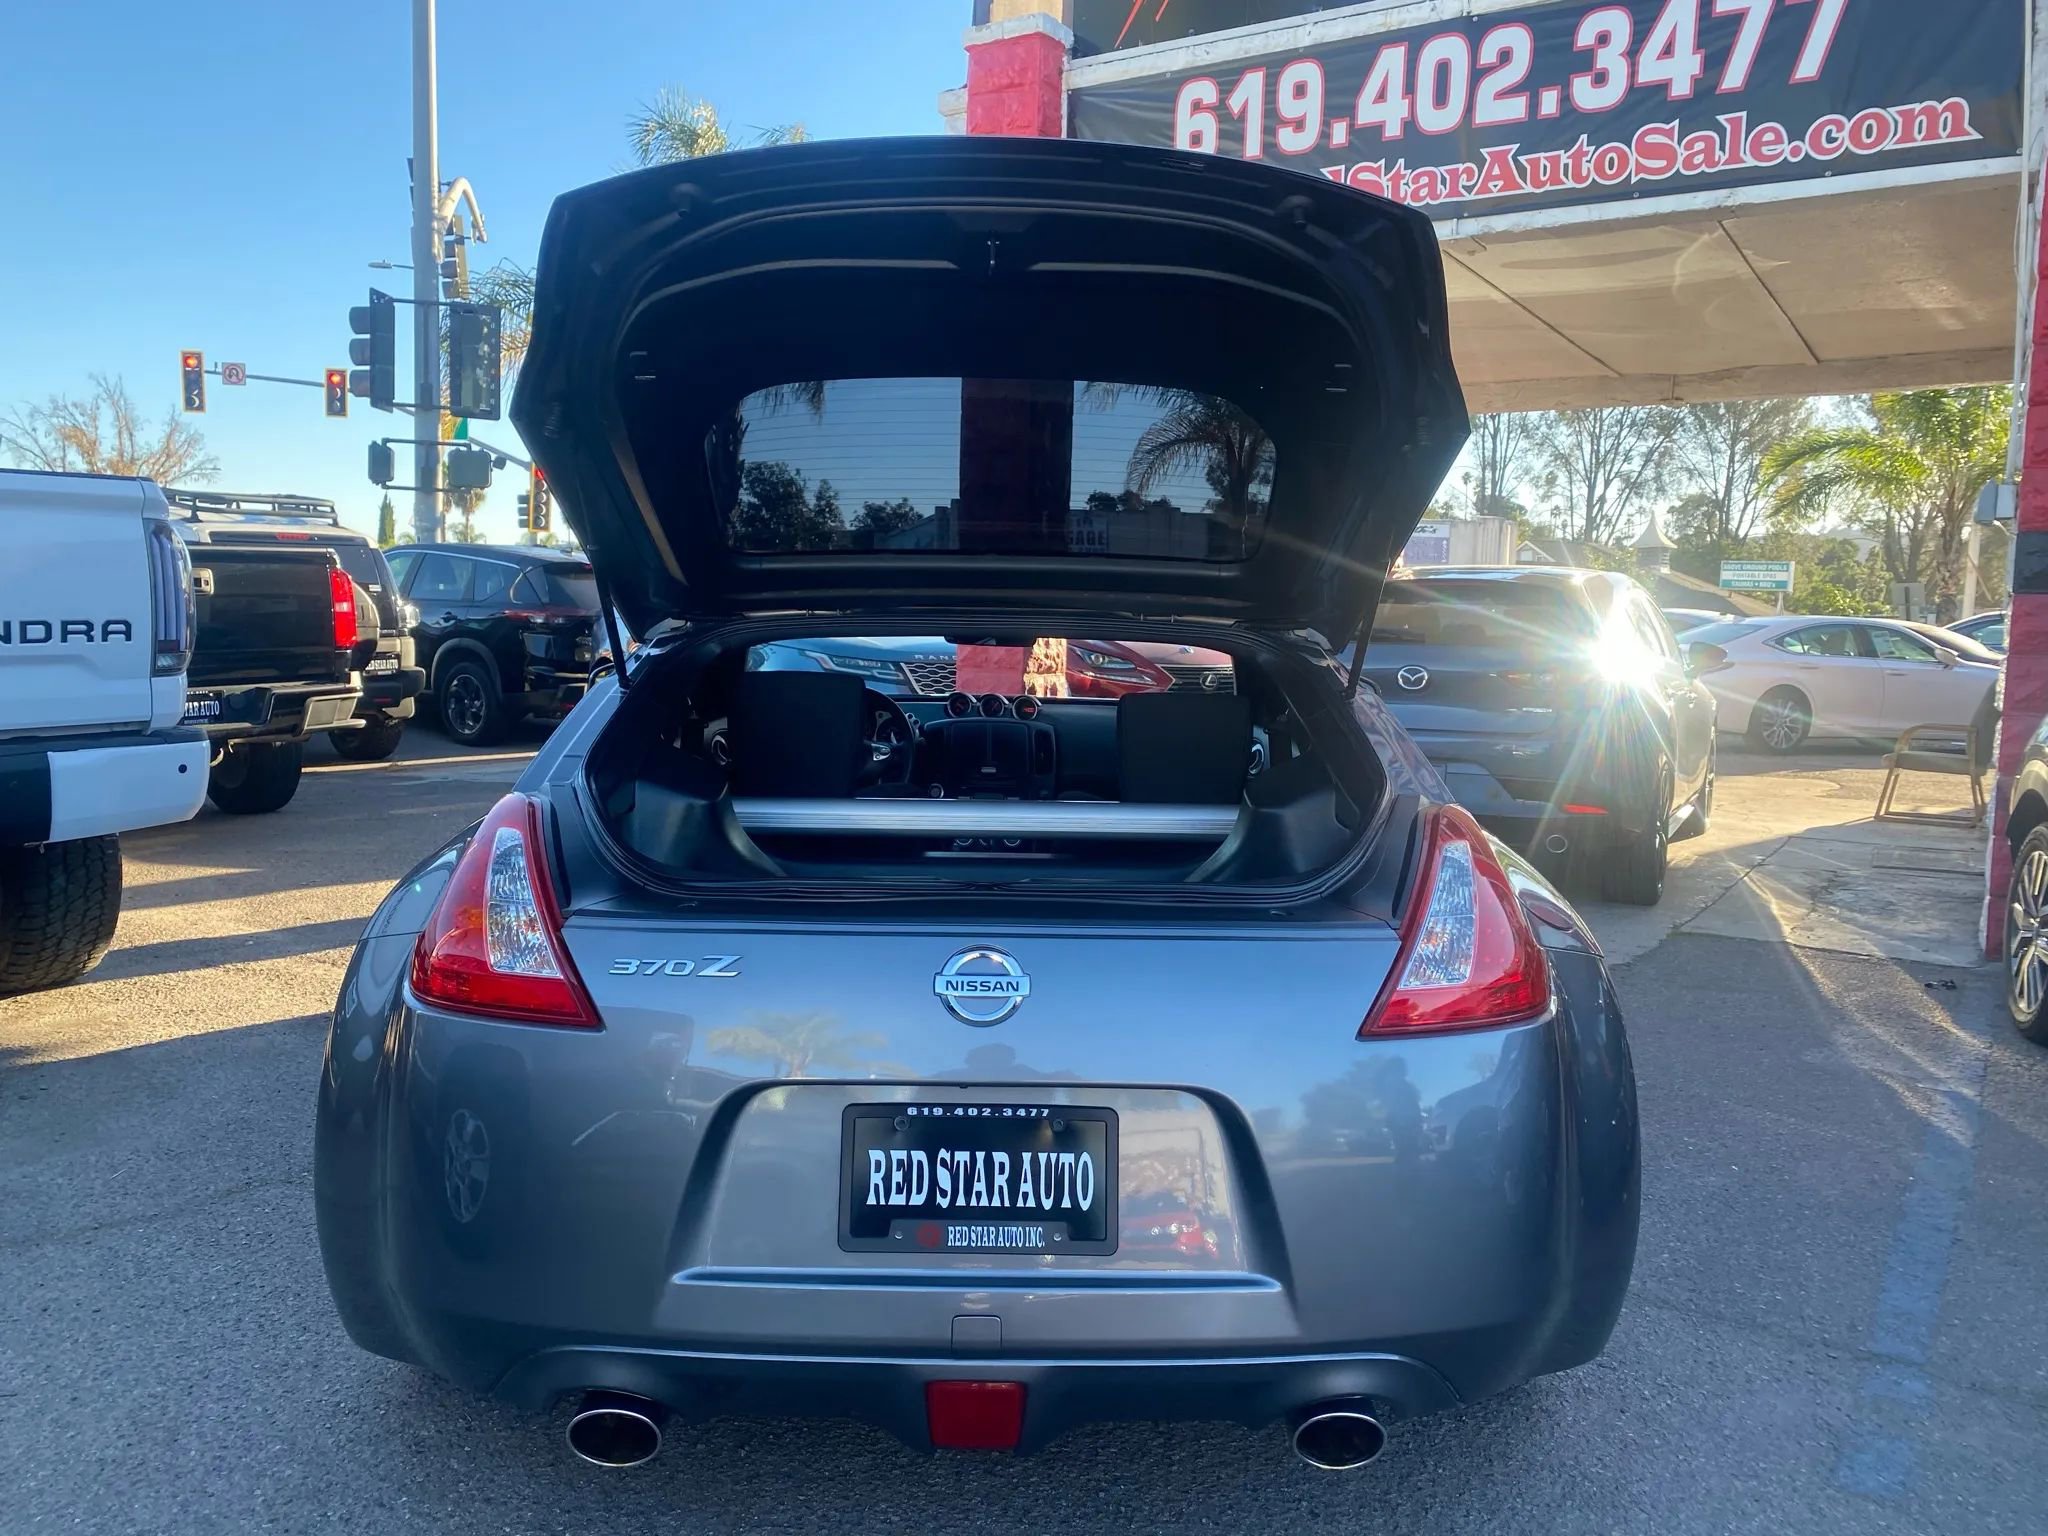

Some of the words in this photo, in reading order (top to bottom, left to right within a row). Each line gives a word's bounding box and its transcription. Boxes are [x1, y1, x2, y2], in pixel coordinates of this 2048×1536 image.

[1174, 0, 1848, 159] 619.402.3477
[200, 700, 220, 716] AUTO
[945, 980, 1019, 992] NISSAN
[907, 1107, 1051, 1117] 619.402.3477
[866, 1149, 930, 1207] RED
[936, 1147, 1011, 1209] STAR
[1016, 1150, 1095, 1211] AUTO
[947, 1226, 969, 1247] RED
[970, 1225, 996, 1247] STAR
[997, 1226, 1024, 1248] AUTO
[1025, 1226, 1045, 1248] INC.
